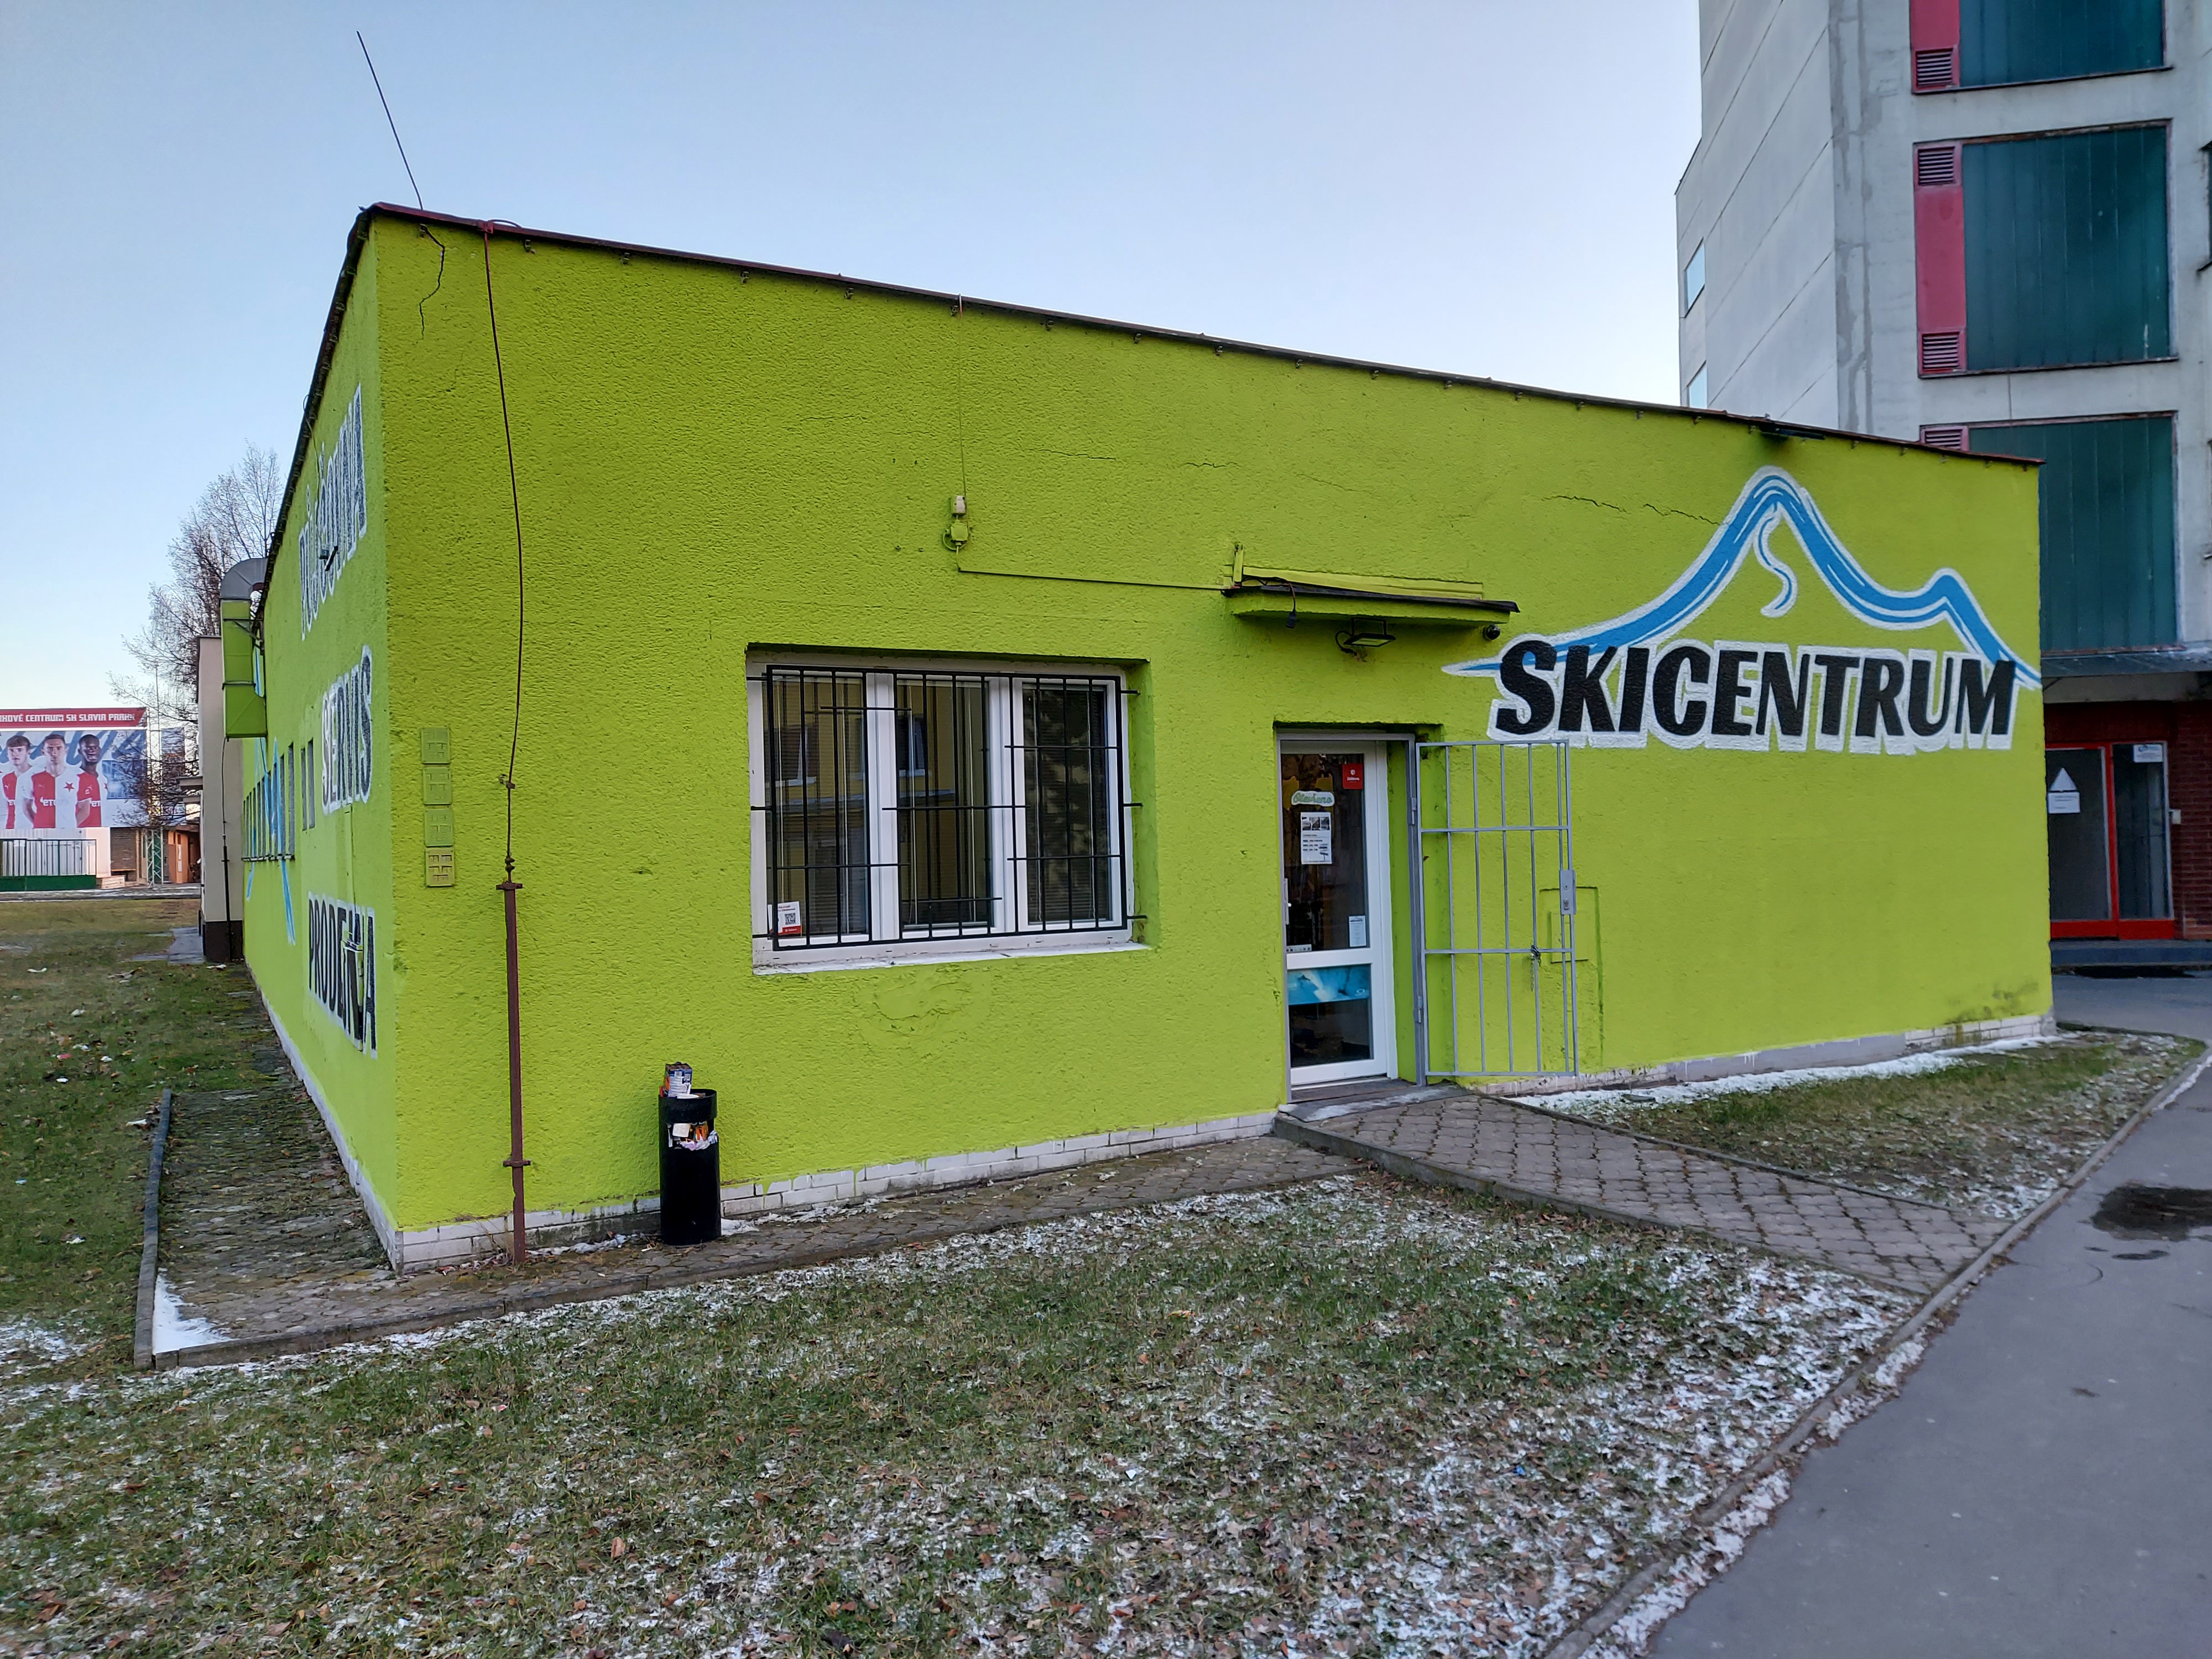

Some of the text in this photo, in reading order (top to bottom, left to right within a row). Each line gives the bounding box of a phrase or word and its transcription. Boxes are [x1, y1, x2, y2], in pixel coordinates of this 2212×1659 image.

[323, 647, 372, 814] SERVIS
[1492, 637, 2020, 741] SKICENTRUM
[308, 893, 377, 1057] PRODEJNA
